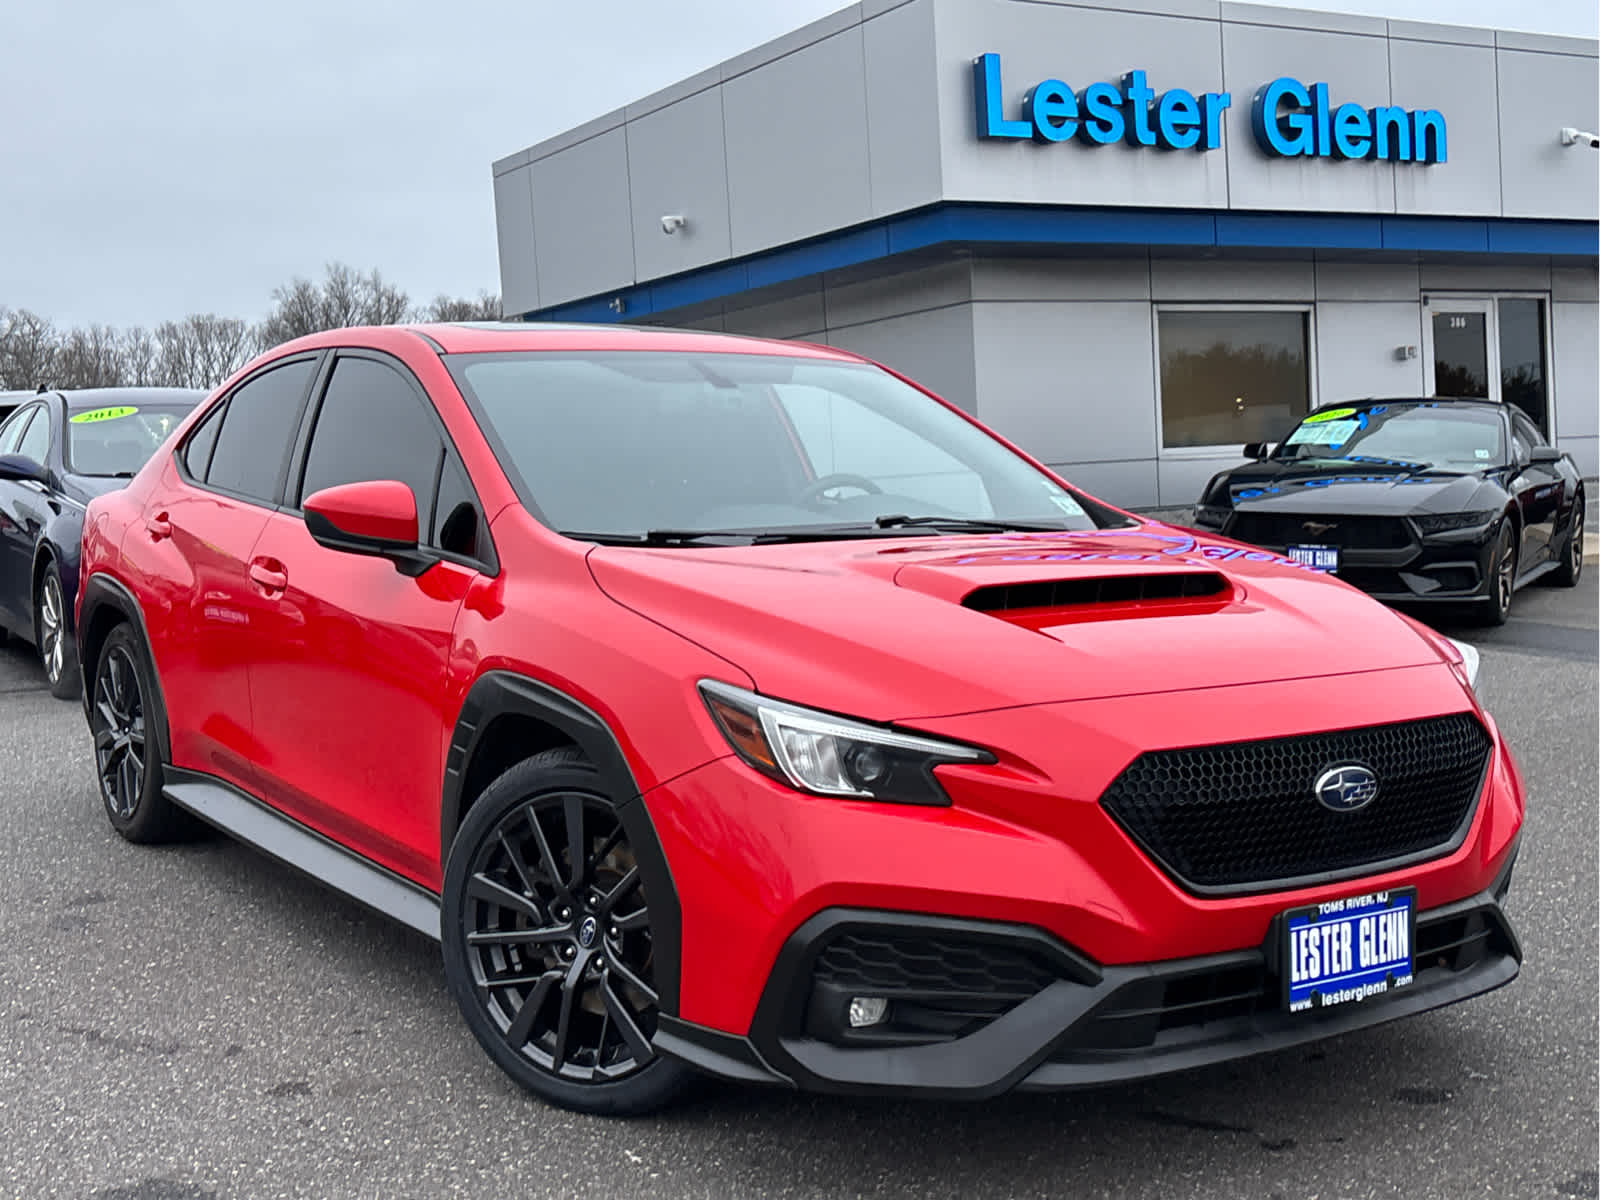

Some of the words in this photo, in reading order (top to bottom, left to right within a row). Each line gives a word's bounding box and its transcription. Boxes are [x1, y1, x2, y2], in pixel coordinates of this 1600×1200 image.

[973, 53, 1231, 150] Lester
[1252, 77, 1447, 164] Glenn
[1318, 901, 1345, 915] TOMS
[1376, 891, 1389, 904] NJ
[1290, 922, 1353, 983] LESTER
[1359, 910, 1409, 968] GLENN
[1321, 981, 1387, 1007] lesterglenn
